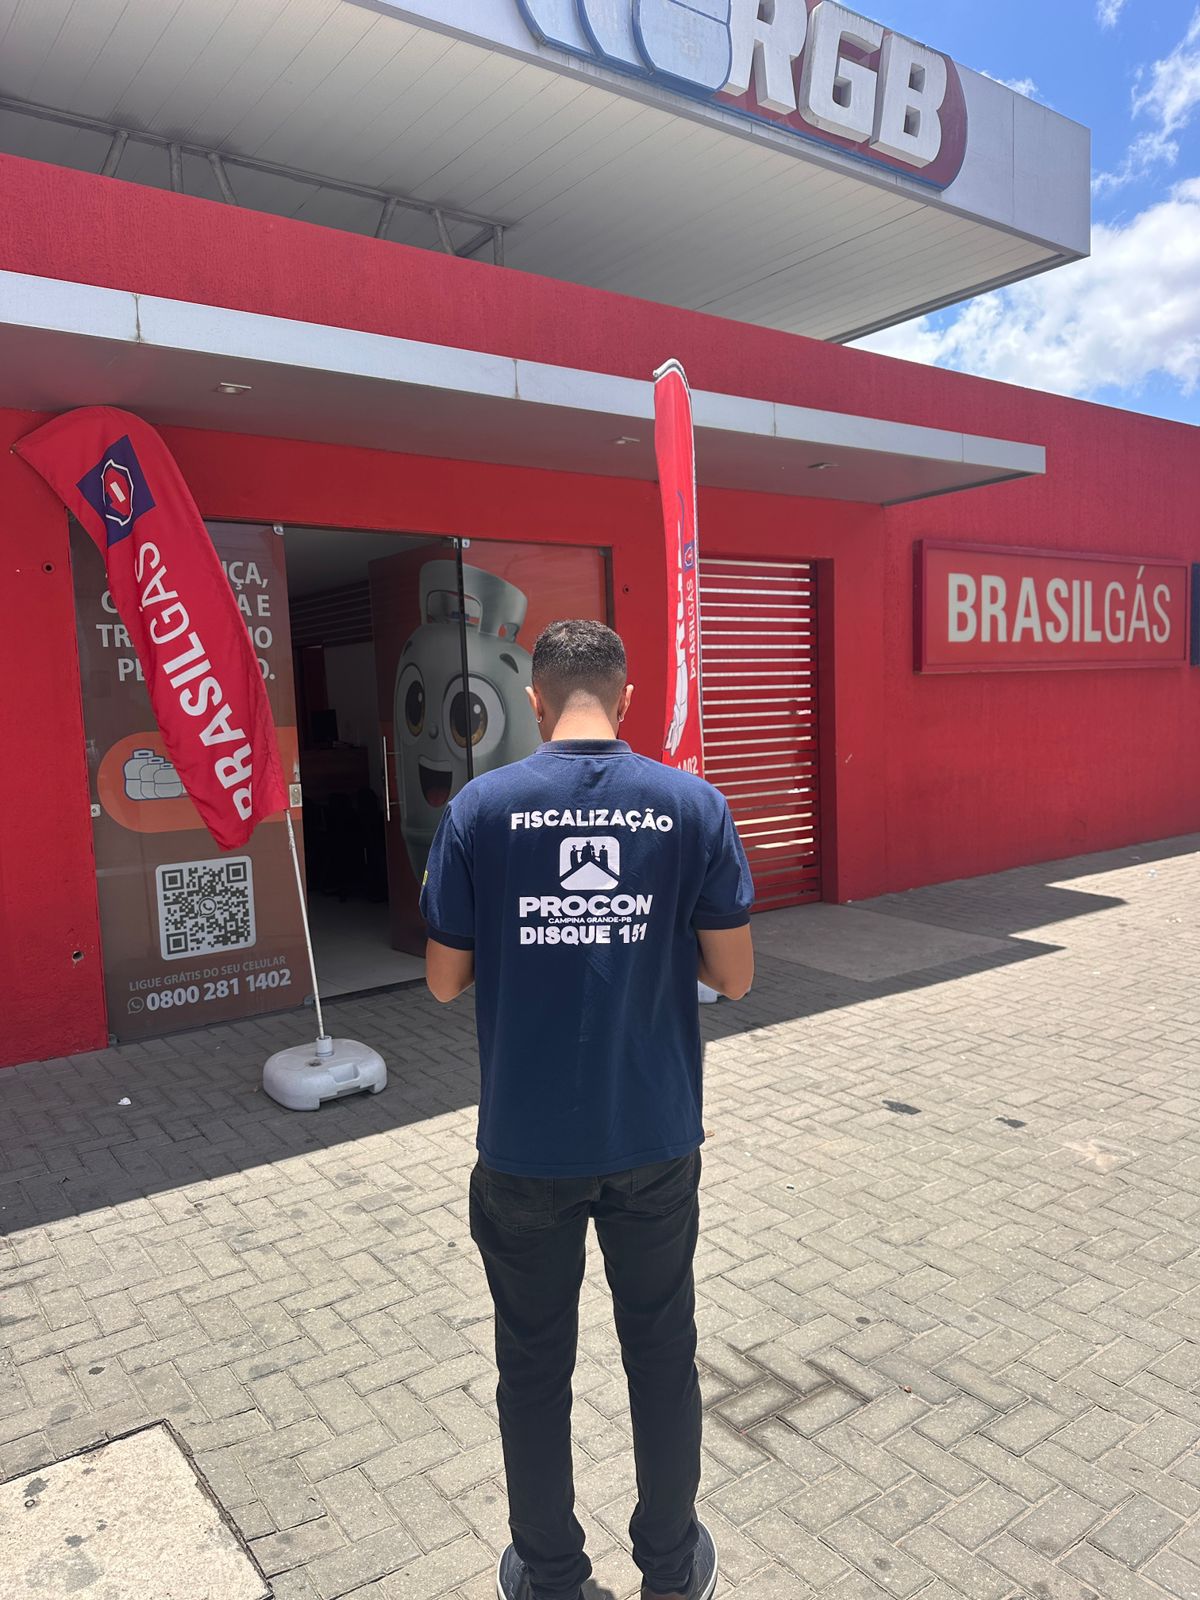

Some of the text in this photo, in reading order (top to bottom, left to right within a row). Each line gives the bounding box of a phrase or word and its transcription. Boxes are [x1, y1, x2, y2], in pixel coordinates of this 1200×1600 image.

[721, 0, 947, 168] RGB
[257, 594, 271, 616] E
[948, 565, 1171, 643] BRASILGÁS
[511, 808, 673, 832] FISCALIZAÇÃO
[519, 894, 653, 917] PROCON
[520, 923, 648, 945] DISQUE 151
[129, 955, 287, 991] LIGUE GRÁTIS DO SEU CELULAR
[146, 968, 292, 1011] 0800 281 1402
